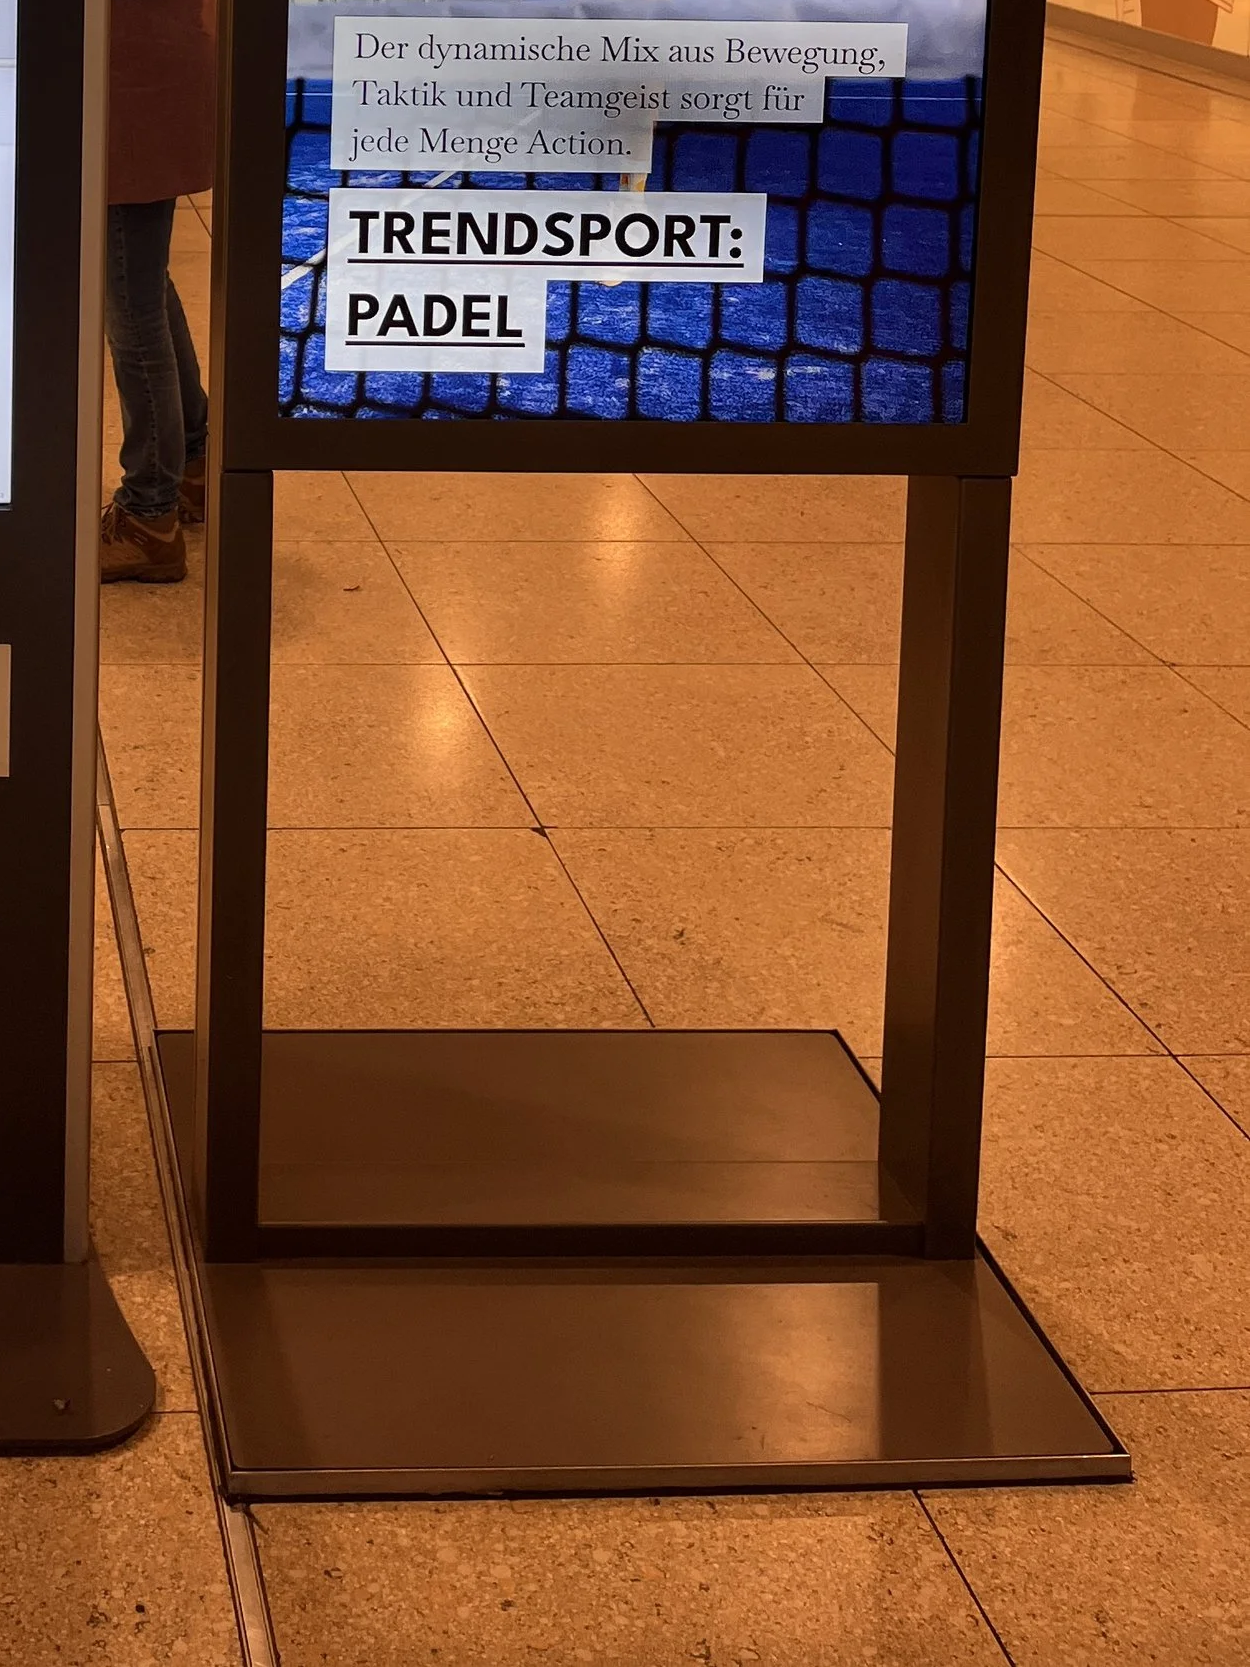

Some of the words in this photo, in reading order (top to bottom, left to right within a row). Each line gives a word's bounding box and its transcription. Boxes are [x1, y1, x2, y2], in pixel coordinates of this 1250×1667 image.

[354, 33, 412, 62] Der
[417, 34, 591, 70] dynamische
[600, 36, 660, 65] Mix
[668, 45, 715, 65] aus
[724, 37, 887, 75] Bewegung,
[352, 79, 447, 109] Taktik
[456, 81, 512, 109] und
[520, 79, 671, 118] Teamgeist
[680, 87, 753, 120] sorgt
[762, 83, 806, 113] für
[348, 128, 407, 162] jede
[418, 128, 518, 163] Menge
[526, 130, 632, 158] Action.
[348, 209, 744, 259] TRENDSPORT:
[348, 292, 524, 340] PADEL
